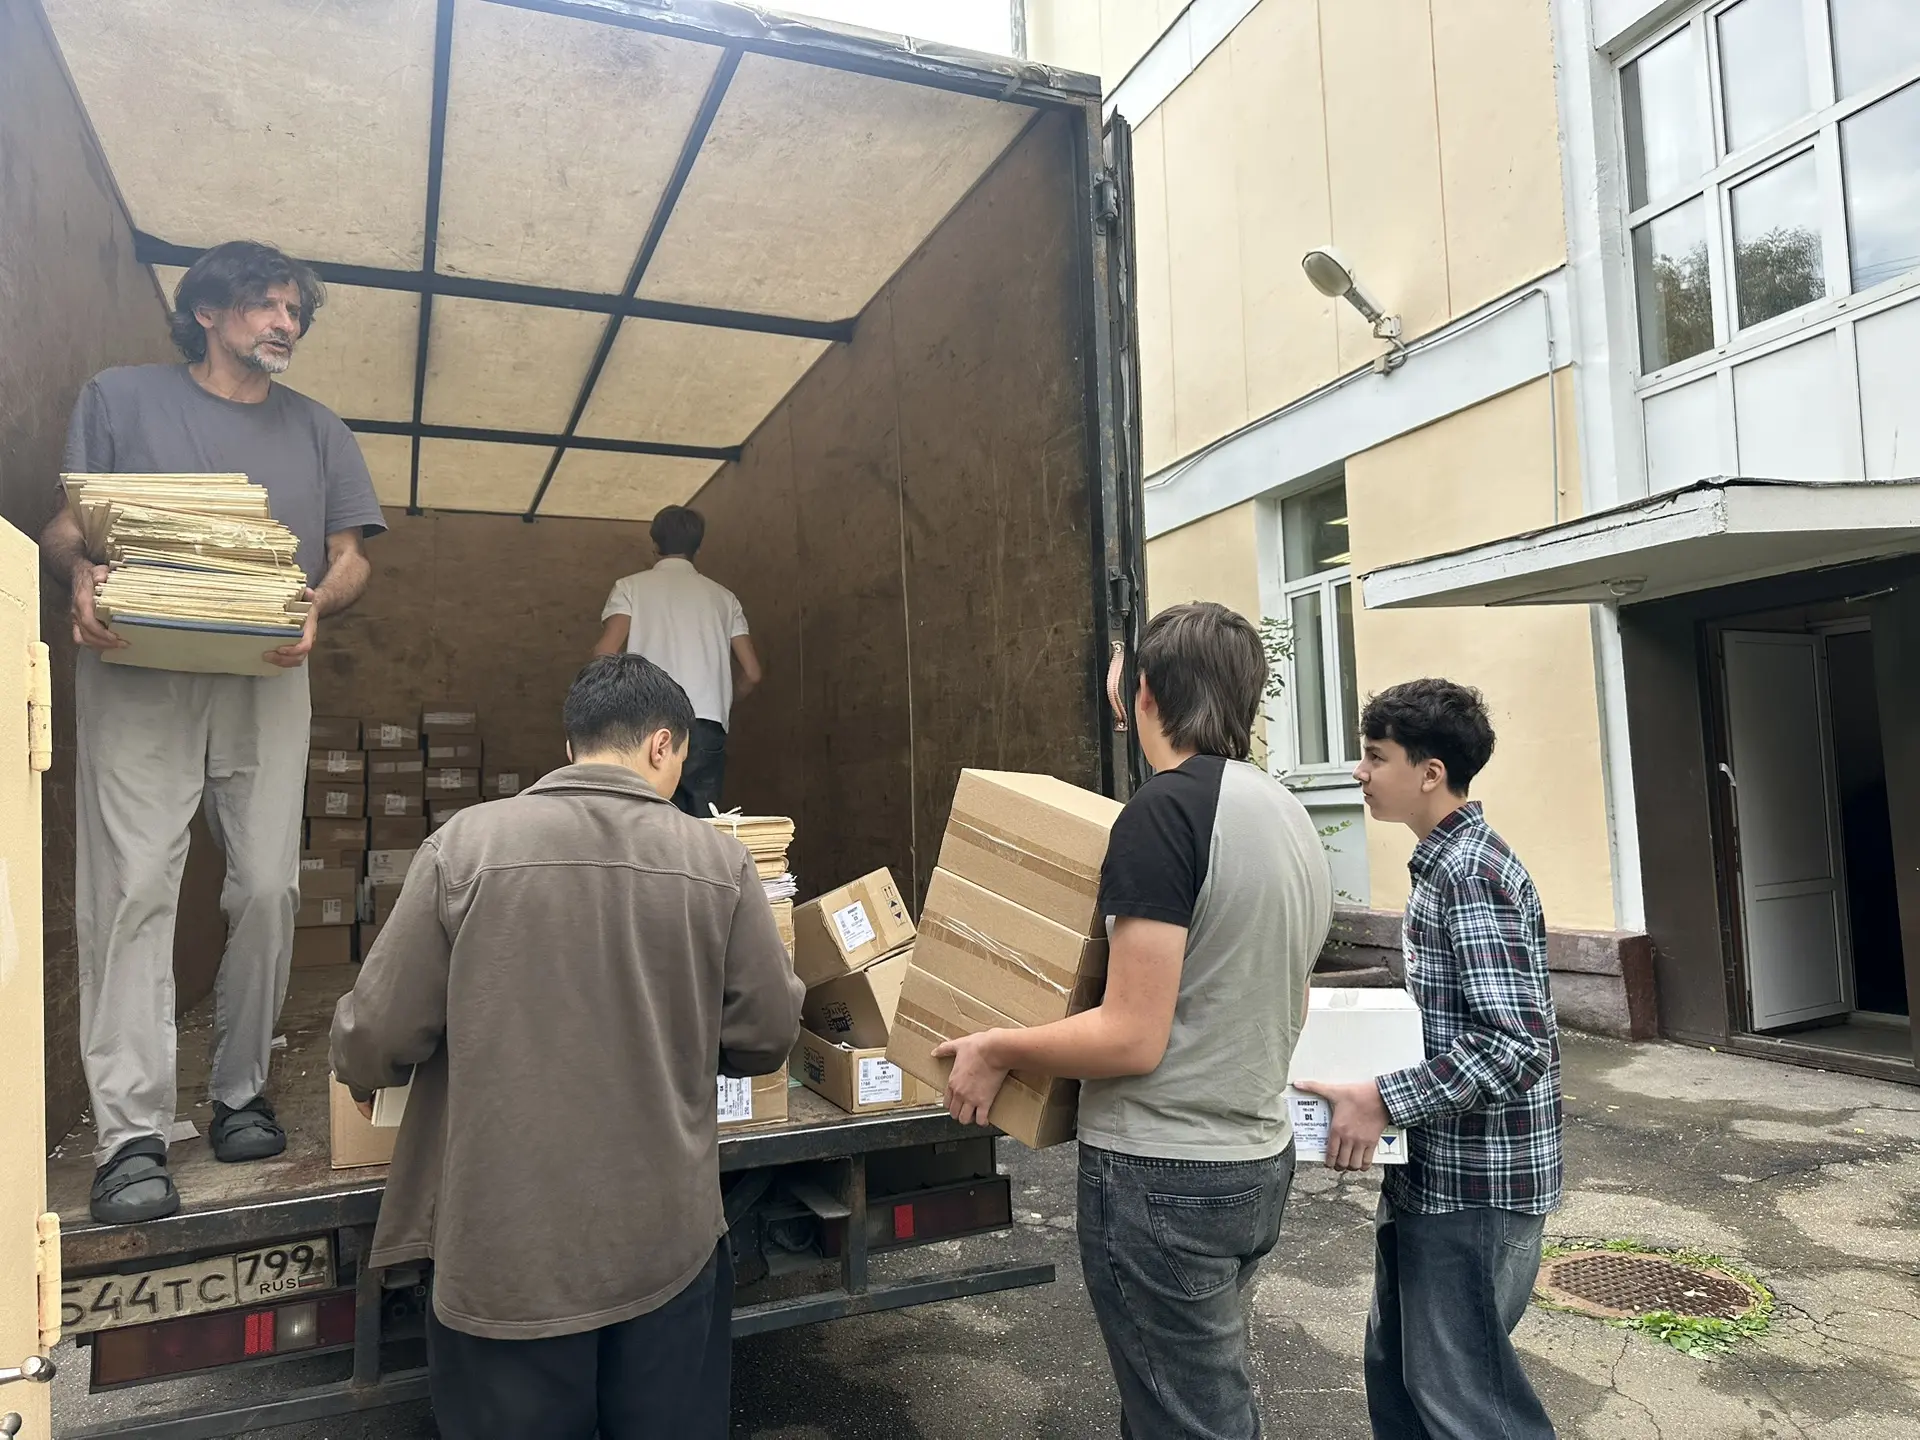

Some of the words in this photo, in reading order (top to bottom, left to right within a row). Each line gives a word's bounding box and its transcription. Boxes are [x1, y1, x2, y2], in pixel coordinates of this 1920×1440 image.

[1305, 1113, 1313, 1121] DL
[237, 1244, 315, 1287] 799
[259, 1277, 297, 1295] RUS
